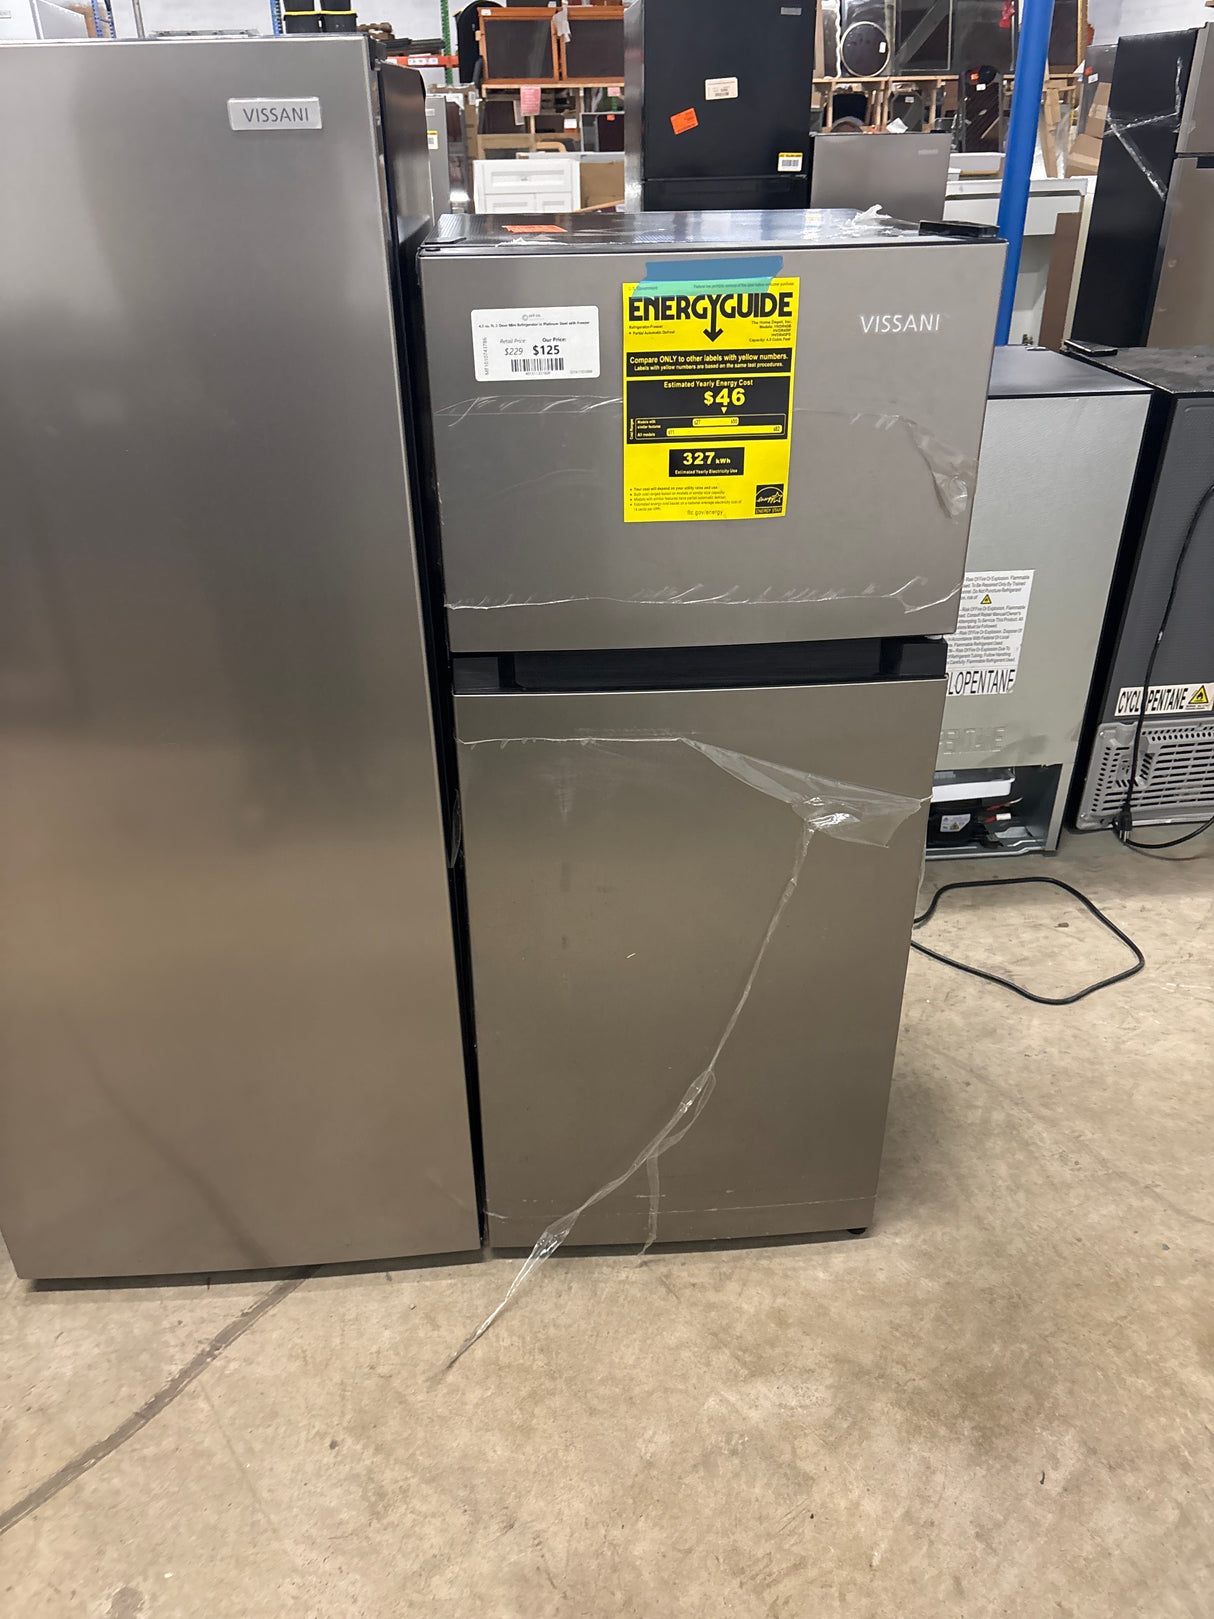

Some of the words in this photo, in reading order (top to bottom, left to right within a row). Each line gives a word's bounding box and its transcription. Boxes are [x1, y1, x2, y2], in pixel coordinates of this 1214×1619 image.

[243, 108, 308, 122] VISSANI
[629, 292, 793, 321] ENERGYGUIDE
[861, 314, 940, 333] VISSANI
[505, 347, 523, 356] $229
[533, 345, 560, 356] $125
[630, 356, 658, 365] Compare
[738, 354, 758, 362] yellow
[716, 379, 737, 387] Energy
[704, 388, 745, 406] $46
[683, 452, 715, 465] 327
[946, 669, 1015, 695] LOPENTANE
[1118, 688, 1188, 713] CYCLPENTANE
